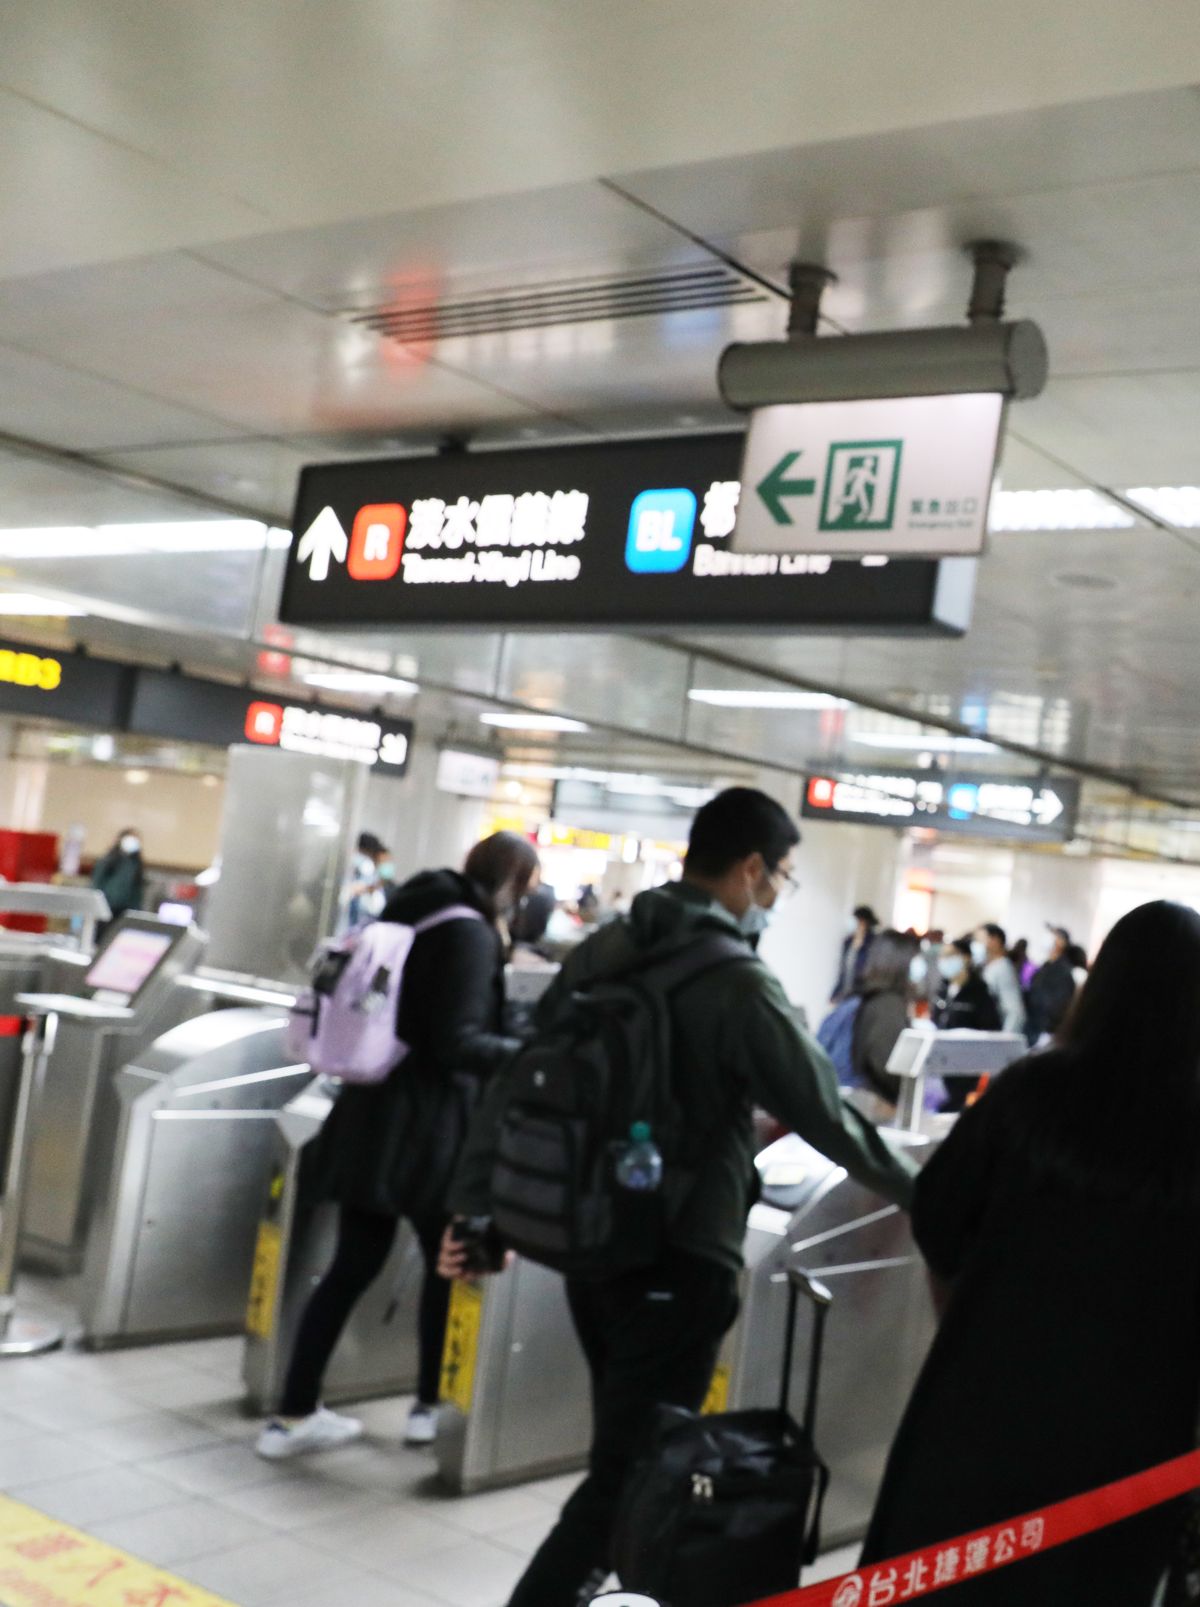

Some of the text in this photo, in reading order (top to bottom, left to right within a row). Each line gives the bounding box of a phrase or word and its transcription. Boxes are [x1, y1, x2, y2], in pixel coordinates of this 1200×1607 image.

[636, 510, 682, 552] BL
[867, 1517, 1045, 1607] 台北捷運公司
